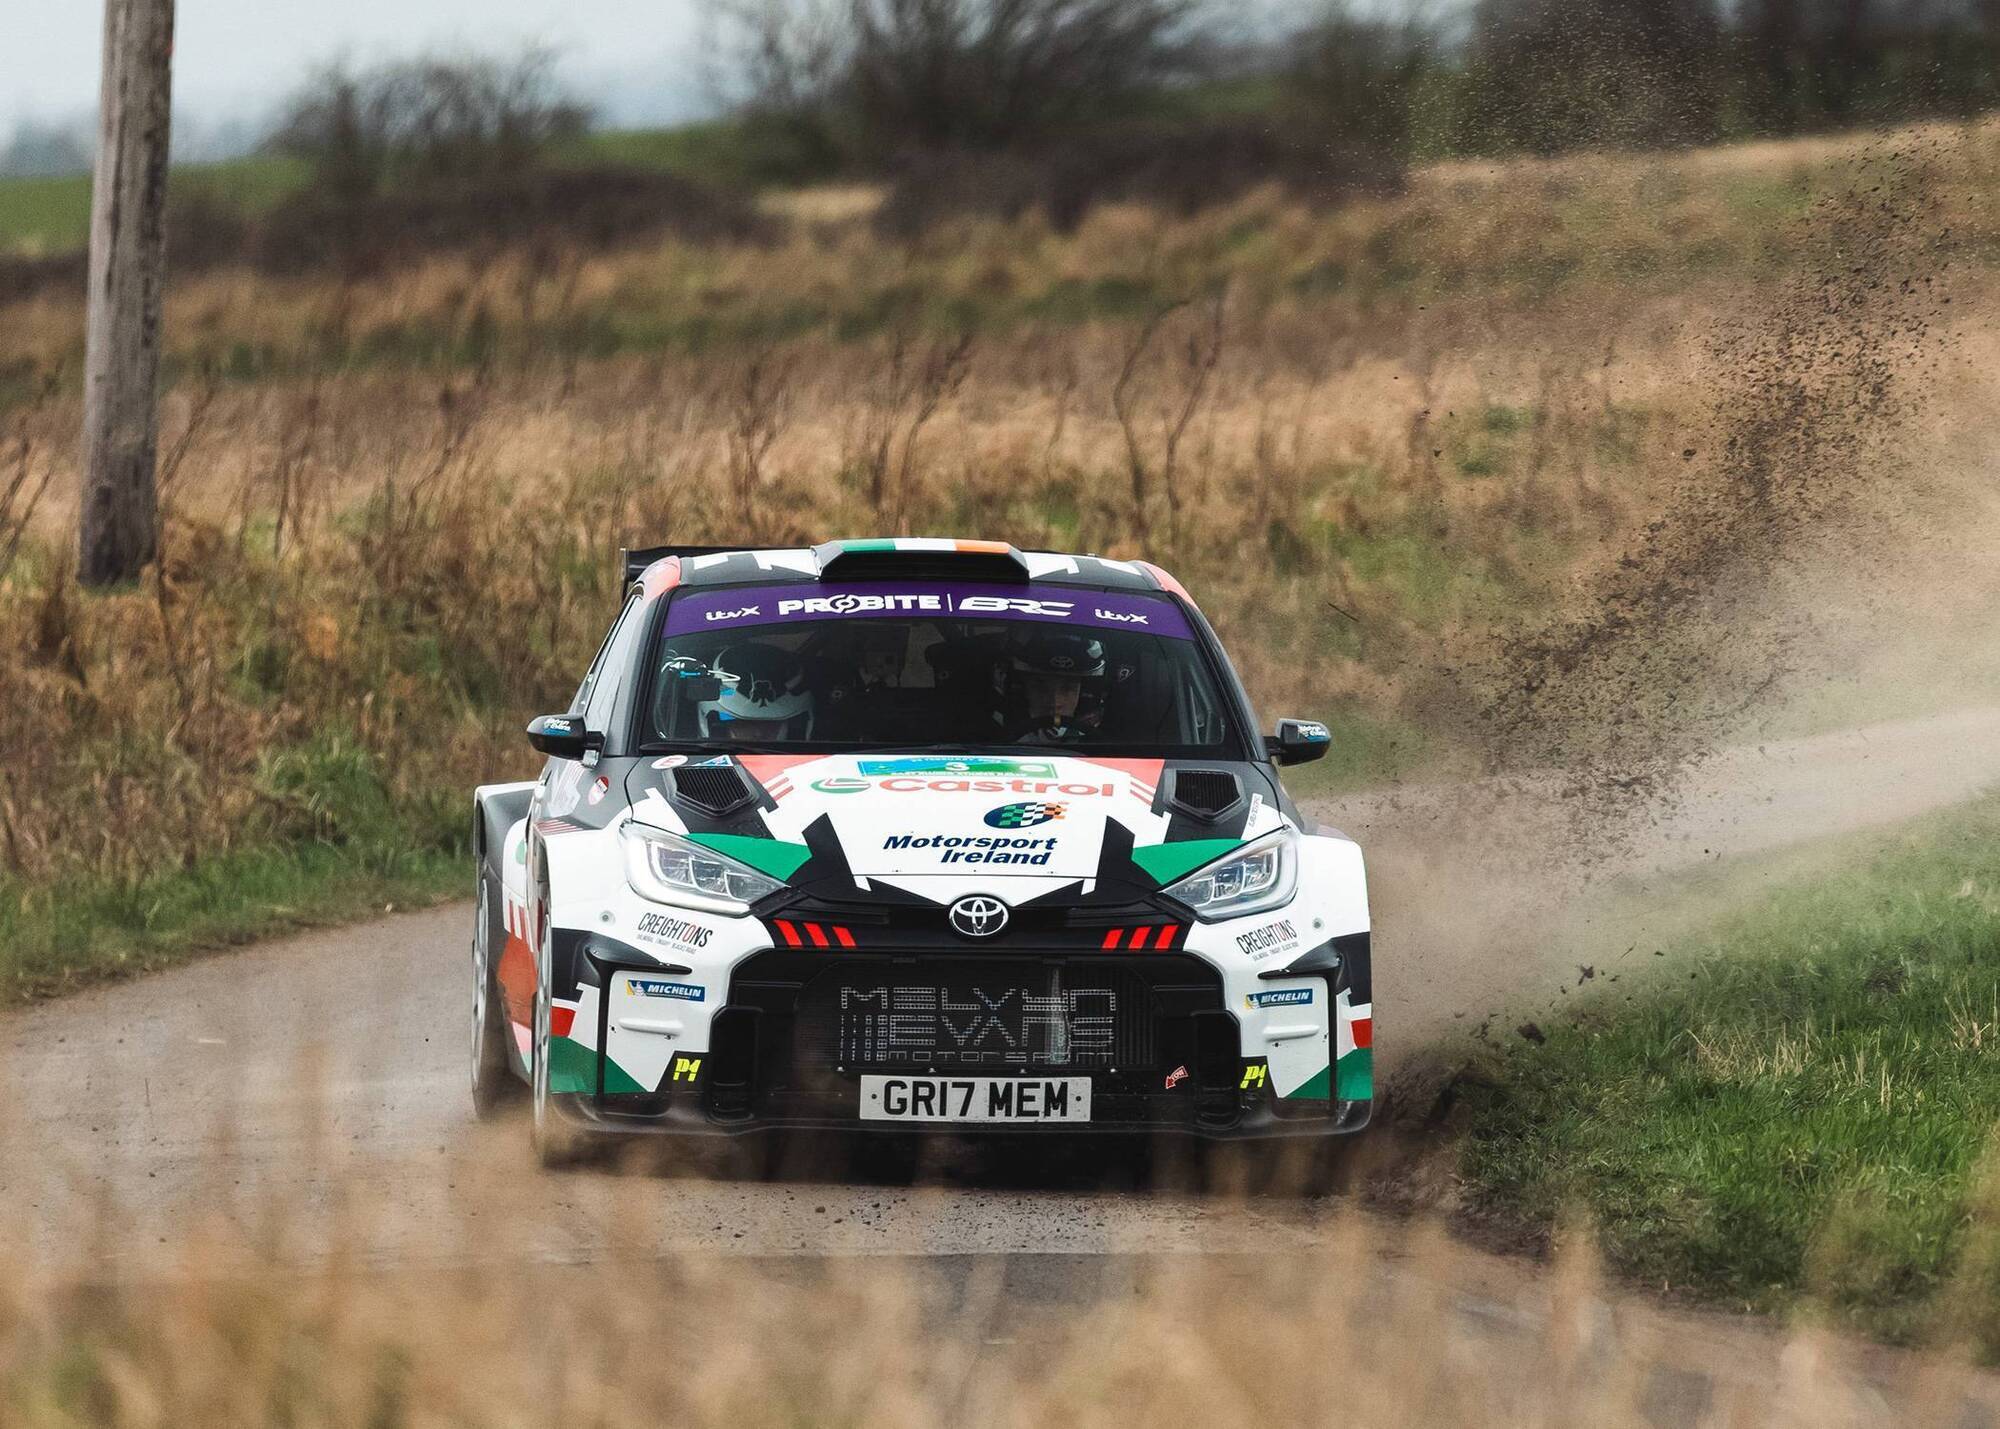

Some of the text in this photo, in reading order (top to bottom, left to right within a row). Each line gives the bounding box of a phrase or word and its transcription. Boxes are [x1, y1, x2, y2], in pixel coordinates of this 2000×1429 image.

[778, 594, 941, 615] PROBITE
[879, 778, 1114, 797] Castrol
[883, 834, 1058, 851] Motorsport
[940, 849, 1052, 865] Ireland
[637, 912, 713, 947] CREIGHTONS
[1235, 919, 1297, 955] CREIGHTONS
[647, 984, 701, 997] MICHELIN
[1260, 991, 1310, 1004] MICHELIN
[883, 1079, 1069, 1118] GR17 MEM
